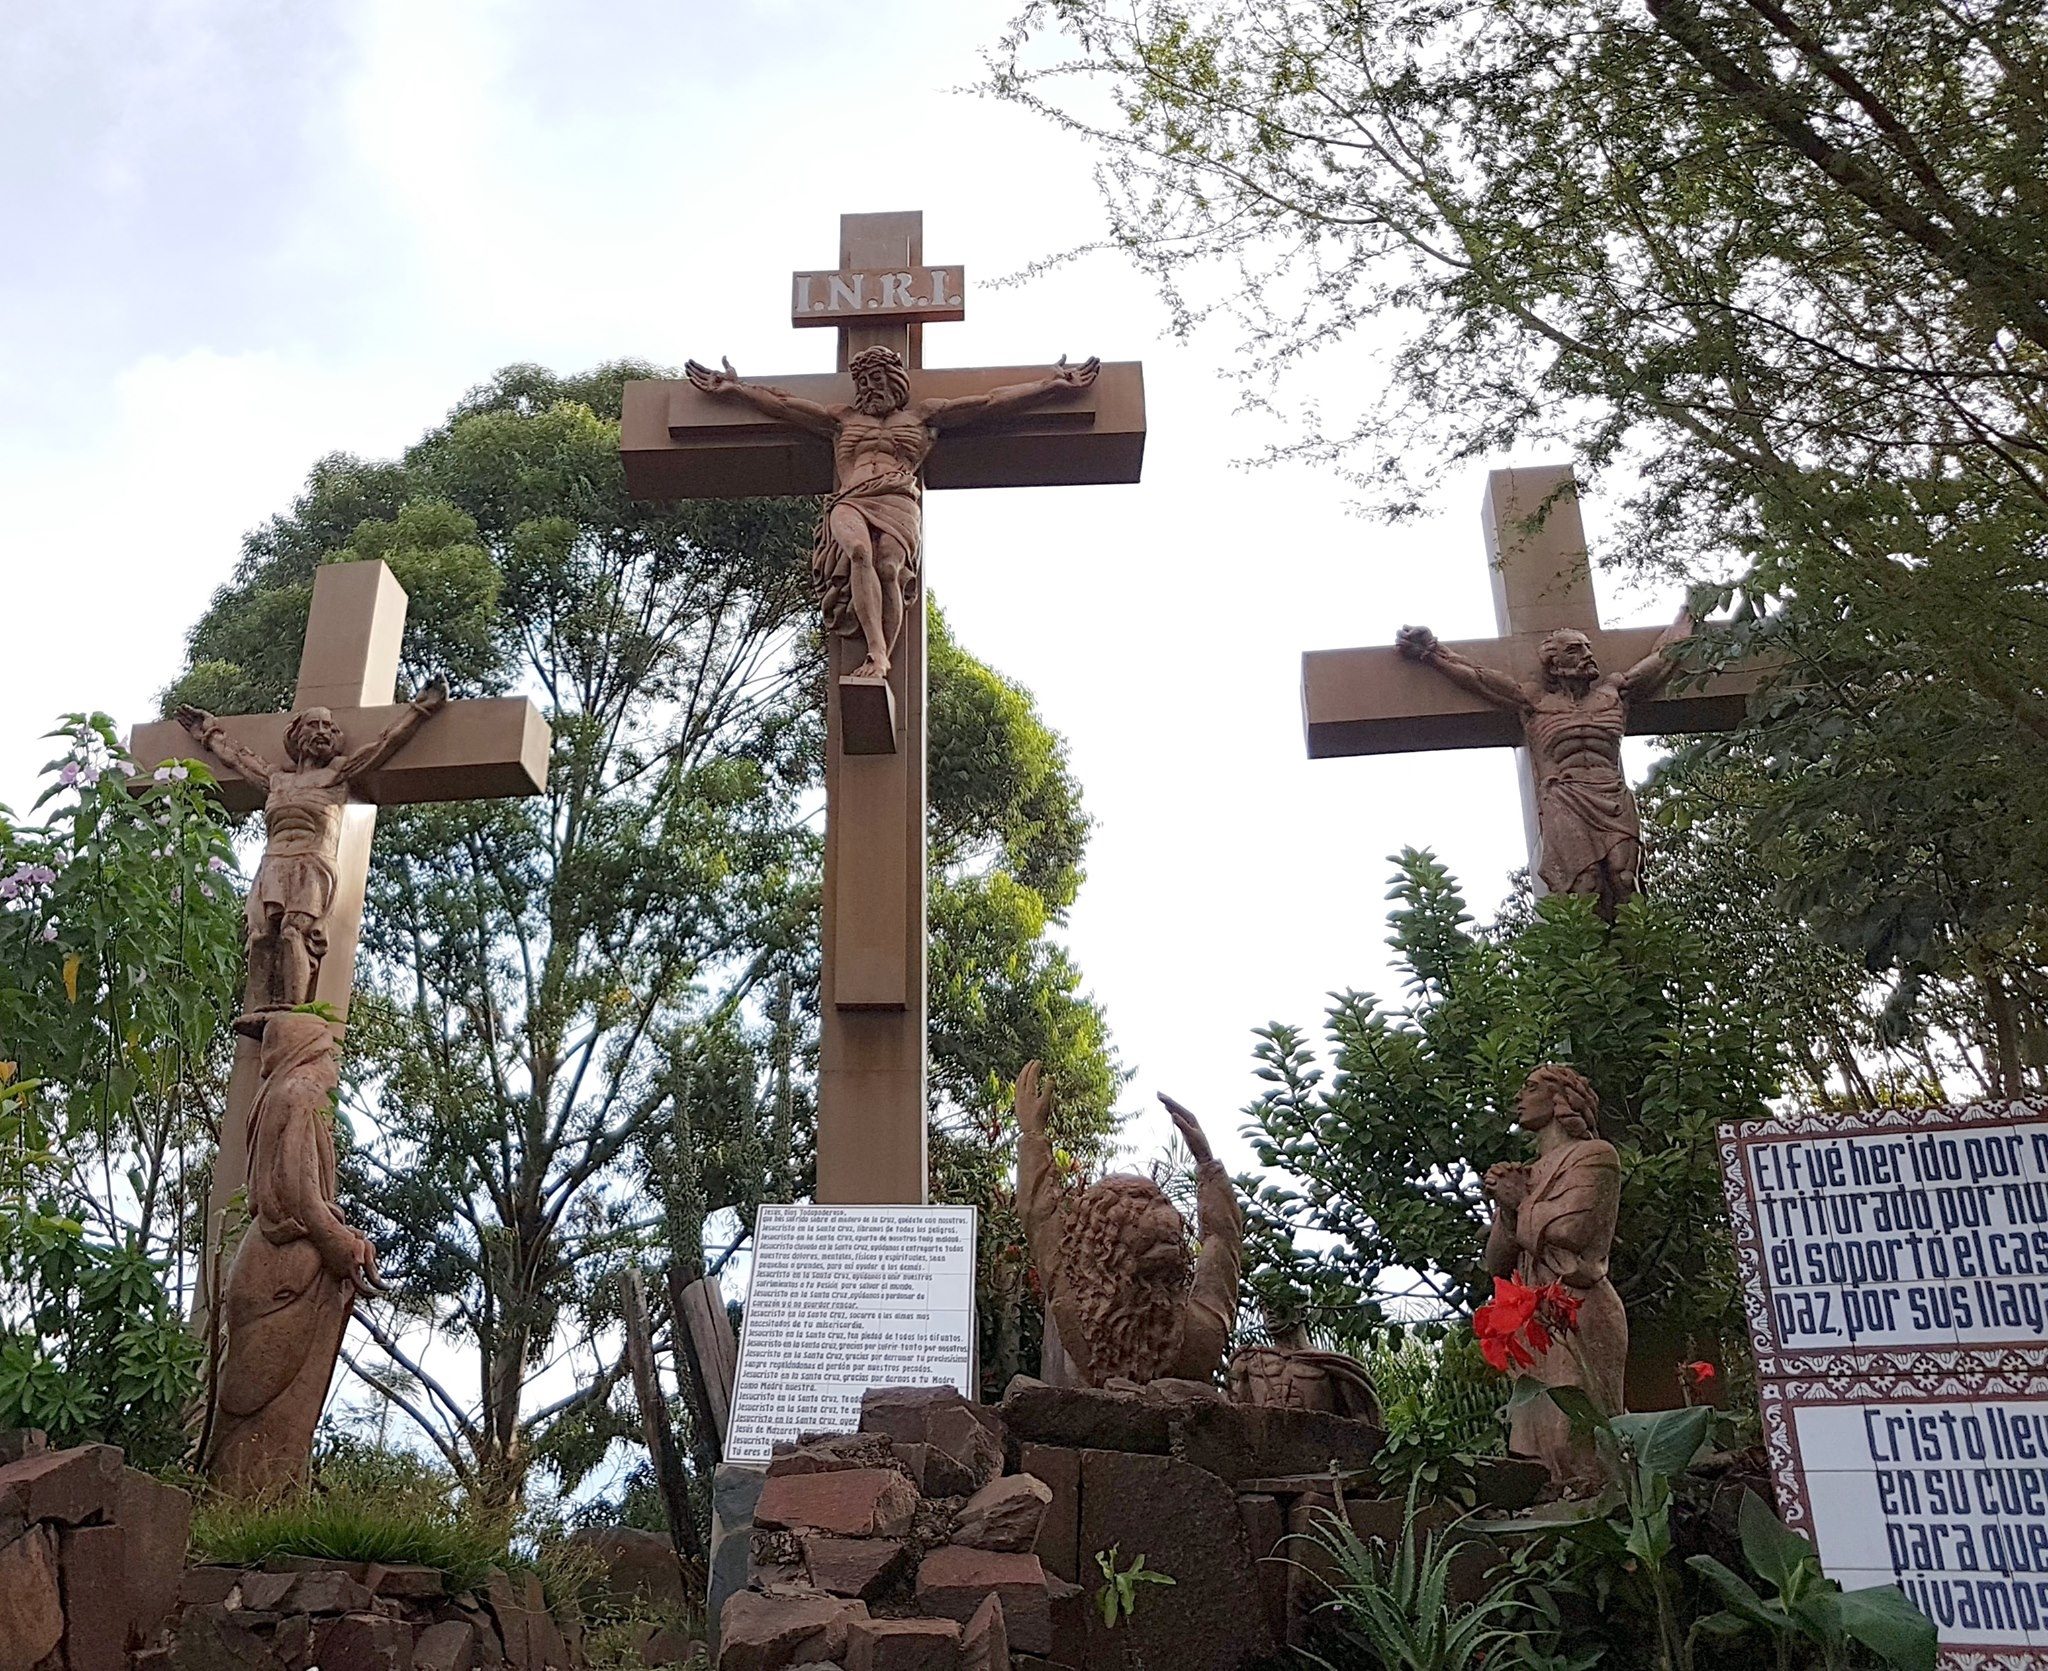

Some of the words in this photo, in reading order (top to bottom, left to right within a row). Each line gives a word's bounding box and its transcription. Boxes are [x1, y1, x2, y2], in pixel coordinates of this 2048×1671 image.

[1786, 1141, 1845, 1189] fué
[1847, 1134, 1960, 1186] herido
[1965, 1134, 2024, 1183] por
[1762, 1184, 1933, 1237] triturado
[1938, 1185, 1995, 1235] por
[1771, 1238, 1802, 1285] él
[1807, 1229, 1949, 1288] soportó
[1954, 1230, 1987, 1278] el
[1774, 1291, 1842, 1344] paz,
[1842, 1290, 1901, 1341] por
[1908, 1286, 1972, 1331] sus
[1864, 1409, 1986, 1462] Cristo
[1876, 1470, 1922, 1515] en
[1924, 1470, 1971, 1515] su
[1886, 1523, 1979, 1576] para
[1982, 1524, 2048, 1577] que
